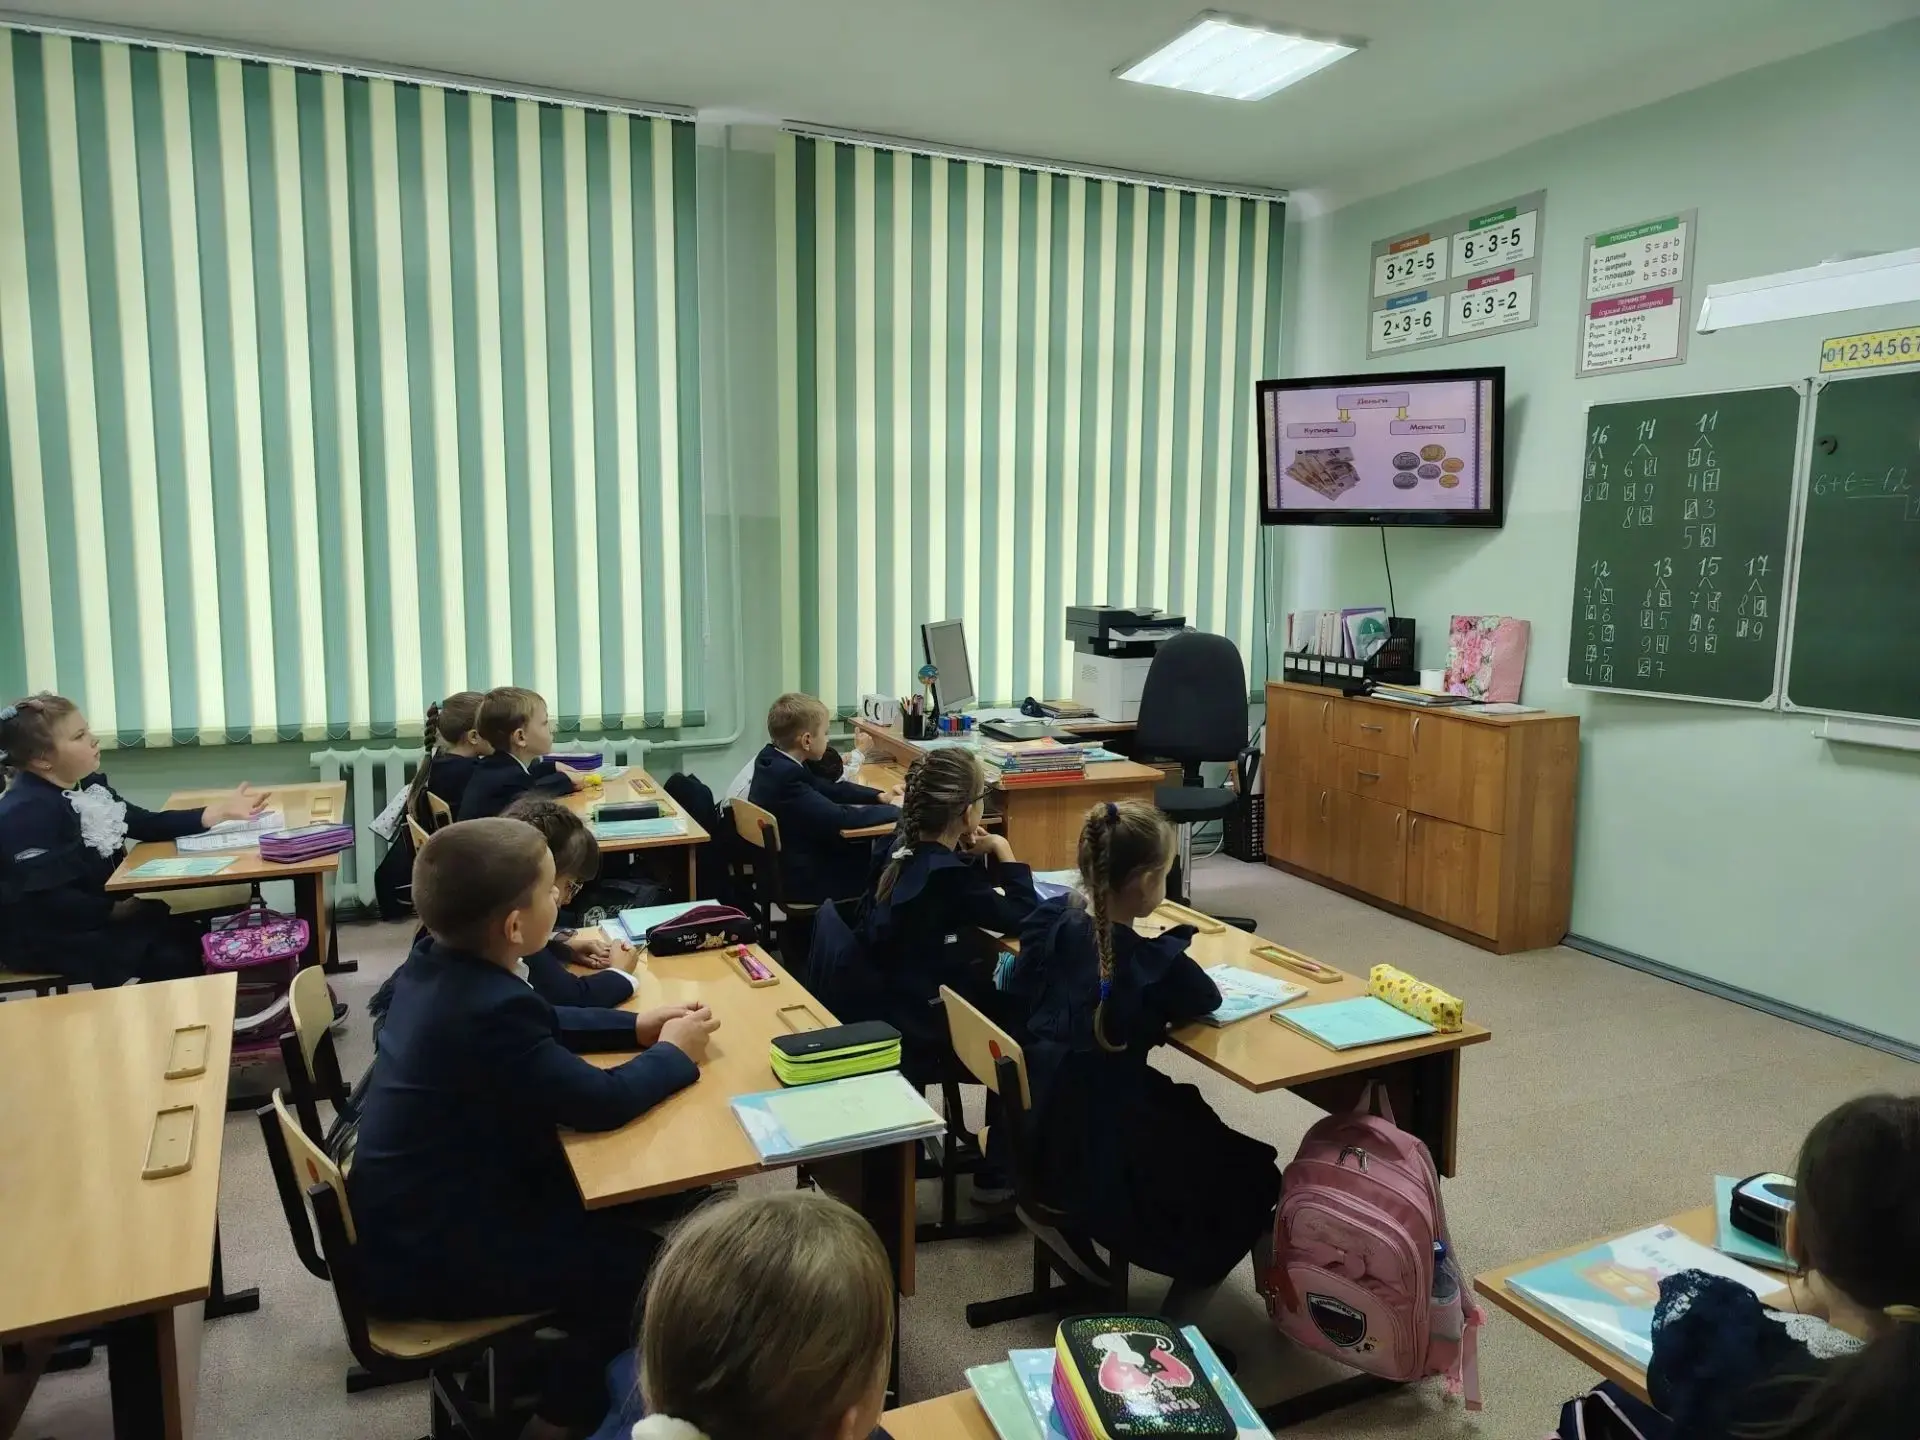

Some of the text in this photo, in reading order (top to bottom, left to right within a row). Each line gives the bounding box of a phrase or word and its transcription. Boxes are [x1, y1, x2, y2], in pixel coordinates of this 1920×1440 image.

[1637, 419, 1656, 440] 14
[1696, 411, 1718, 432] 11
[1592, 424, 1610, 444] 16
[1592, 560, 1611, 577] 12
[1654, 557, 1673, 578] 13
[1699, 557, 1722, 576] 15
[1745, 555, 1771, 576] 17
